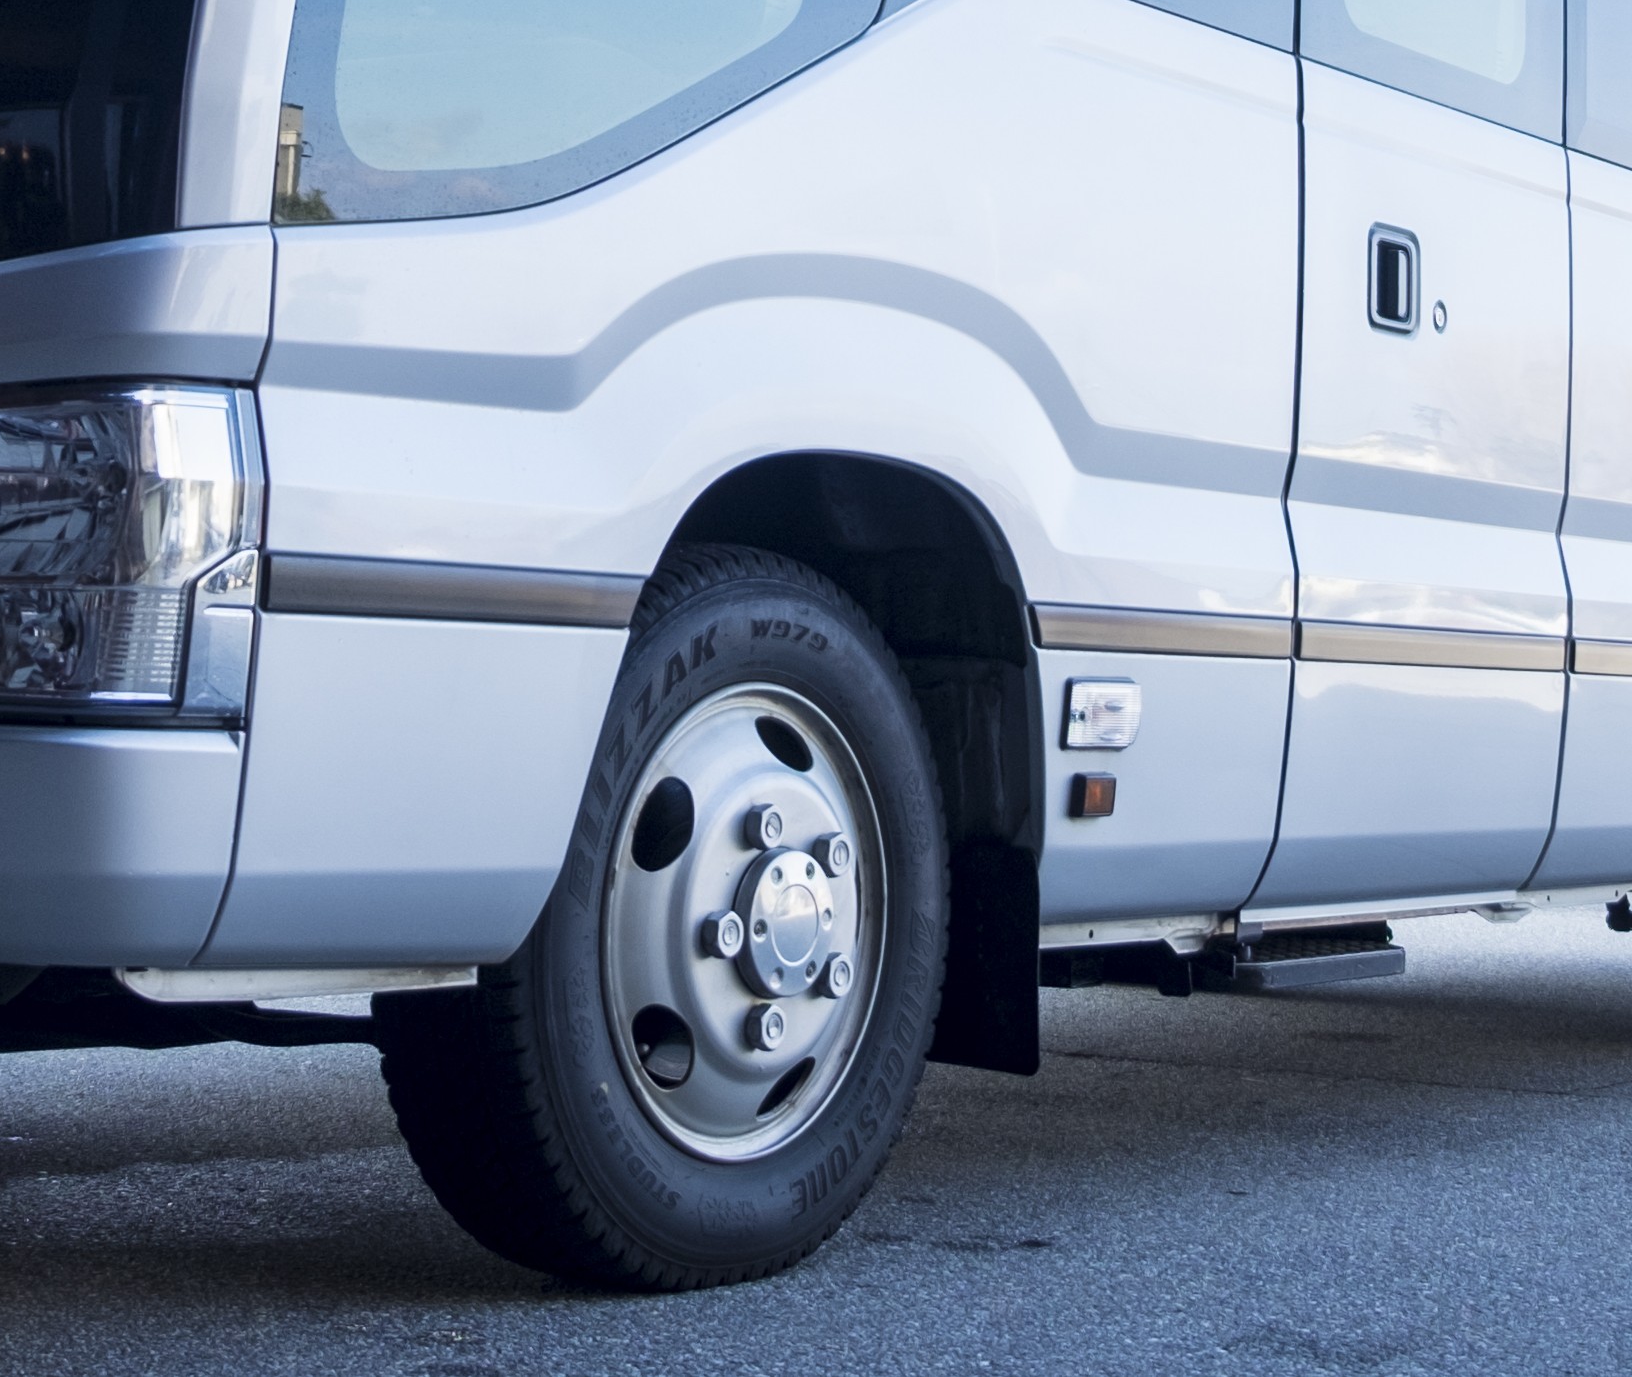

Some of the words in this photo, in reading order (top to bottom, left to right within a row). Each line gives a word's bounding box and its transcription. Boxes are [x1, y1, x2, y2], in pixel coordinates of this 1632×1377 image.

[568, 619, 718, 911] BLIZZAK
[751, 619, 828, 654] W979
[591, 1086, 681, 1210] STUDLESS
[790, 909, 935, 1222] BRIDGESTONE
